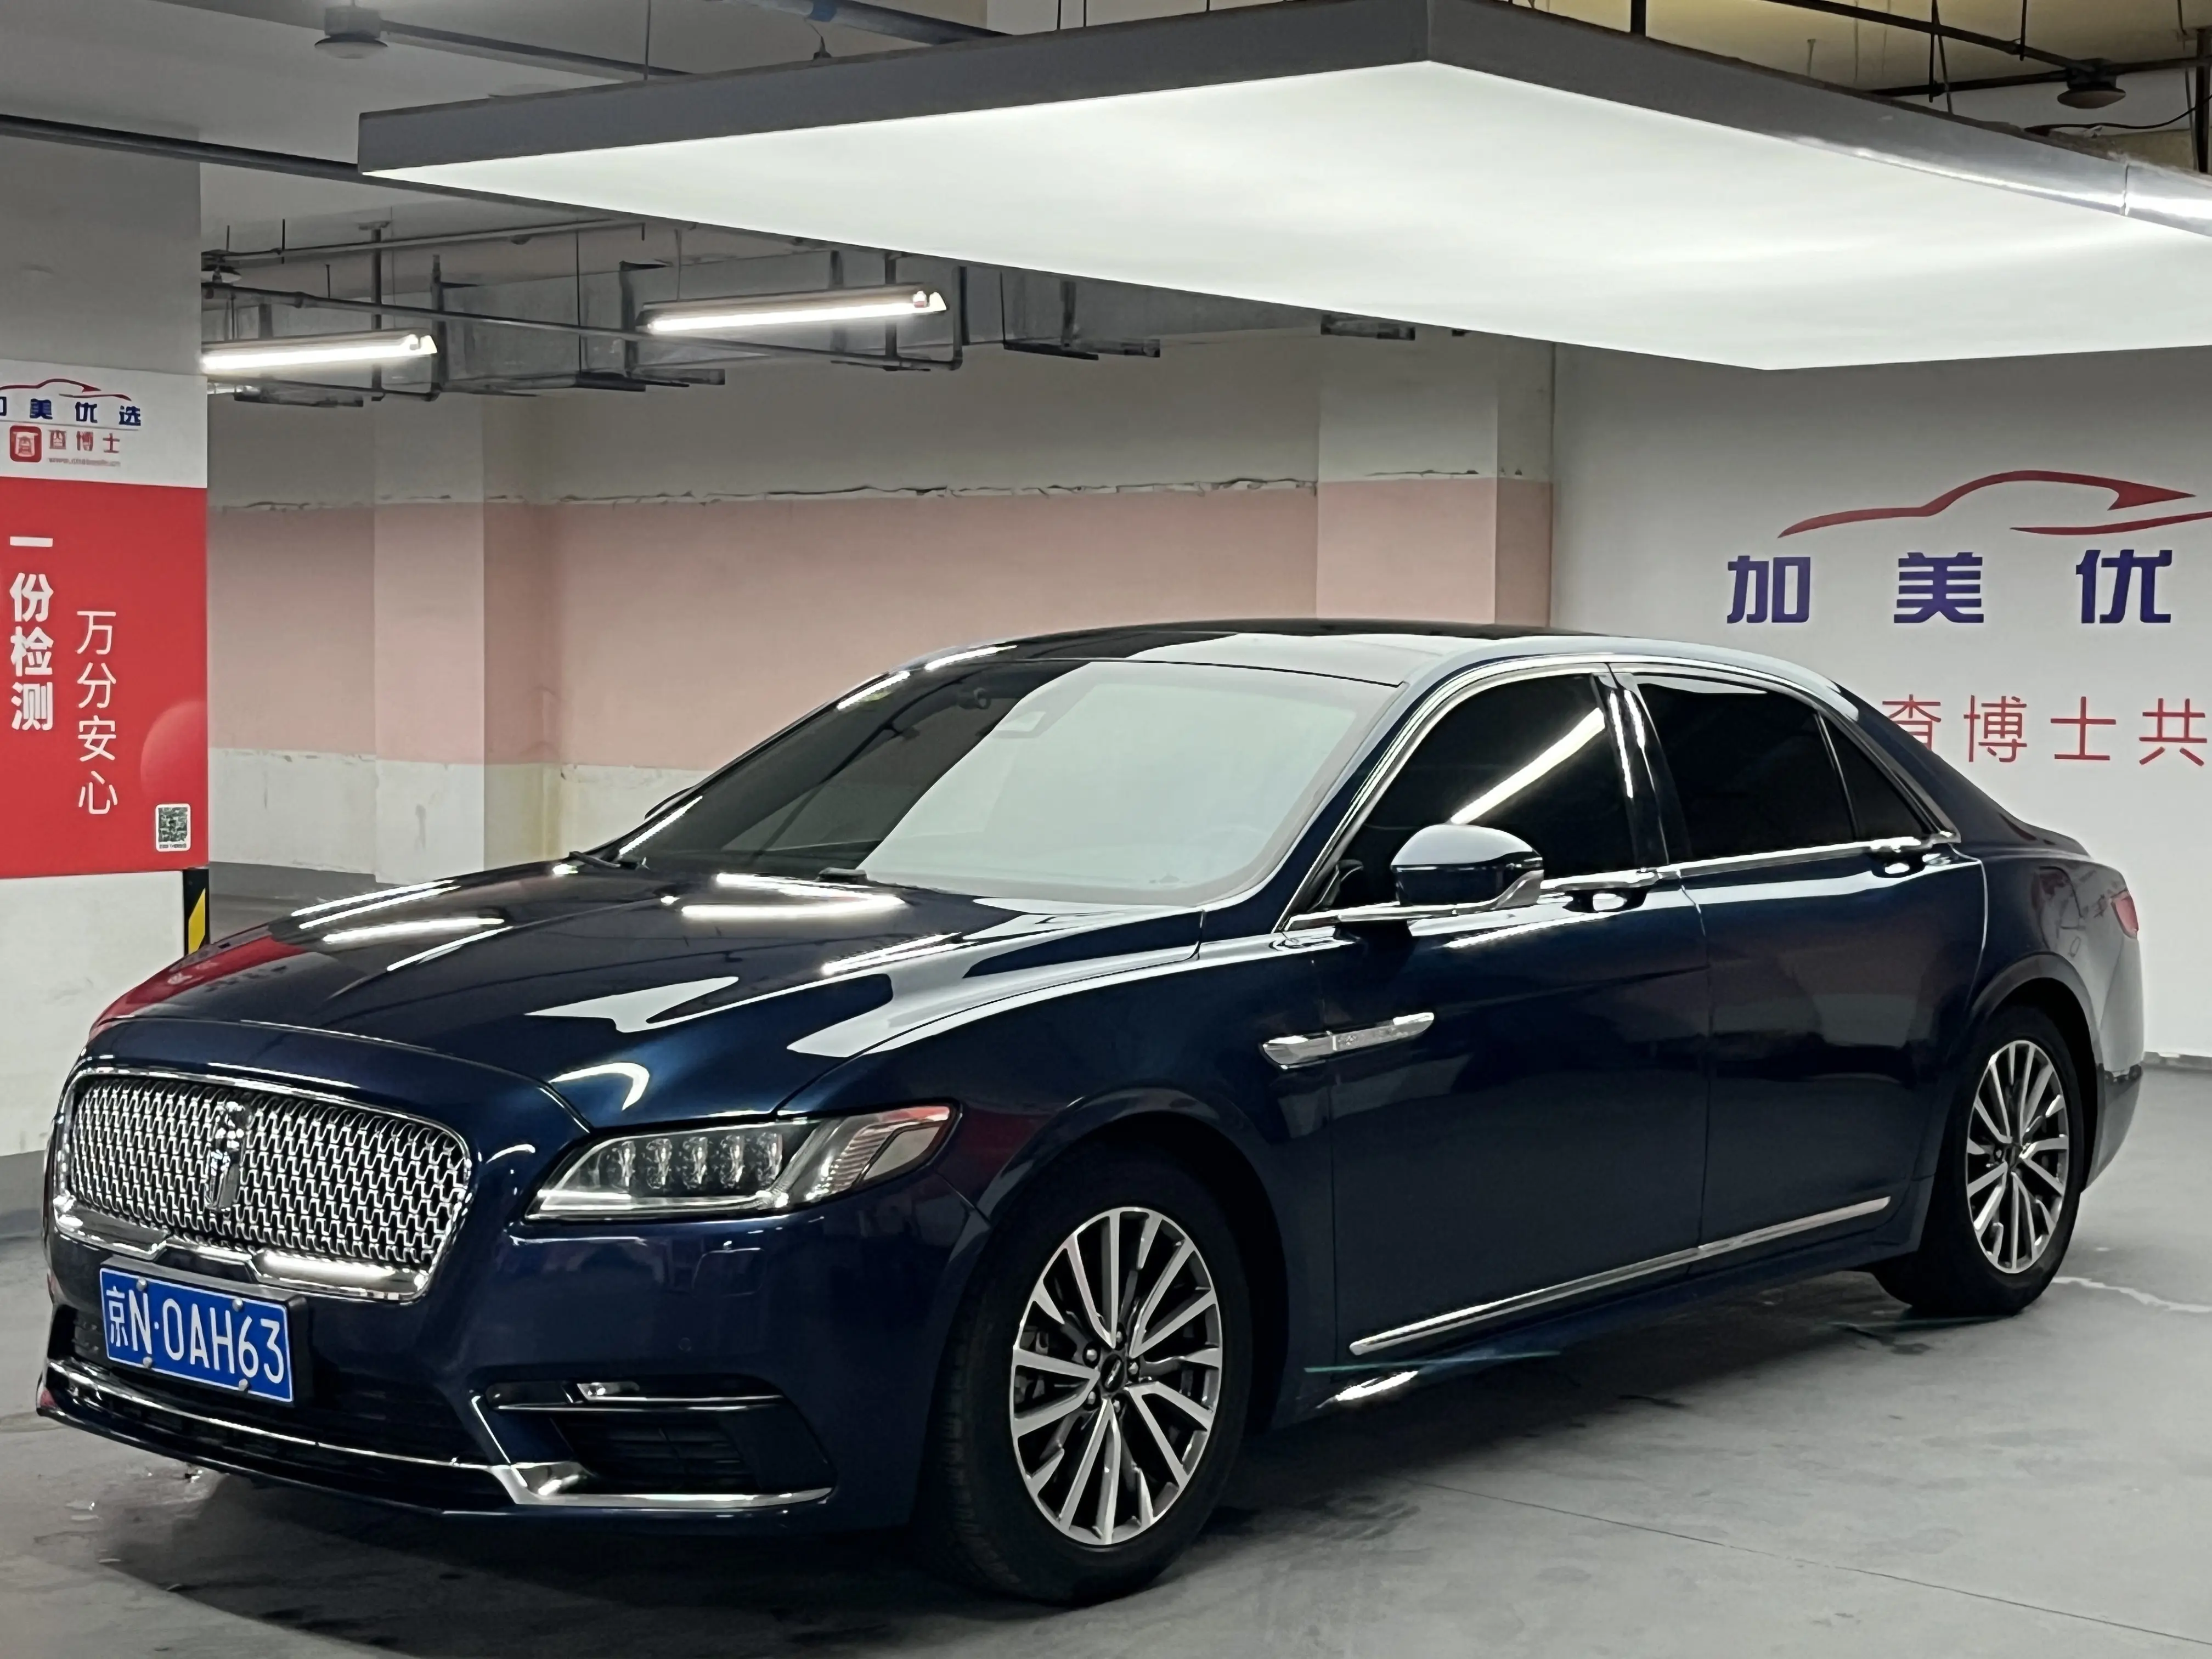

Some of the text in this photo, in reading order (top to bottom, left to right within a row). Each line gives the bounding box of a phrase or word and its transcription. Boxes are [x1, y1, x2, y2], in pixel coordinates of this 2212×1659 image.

[0, 397, 141, 426] 美优选
[9, 536, 54, 731] 一份检测
[1726, 549, 2173, 624] 加美优
[76, 611, 118, 815] 万分安心
